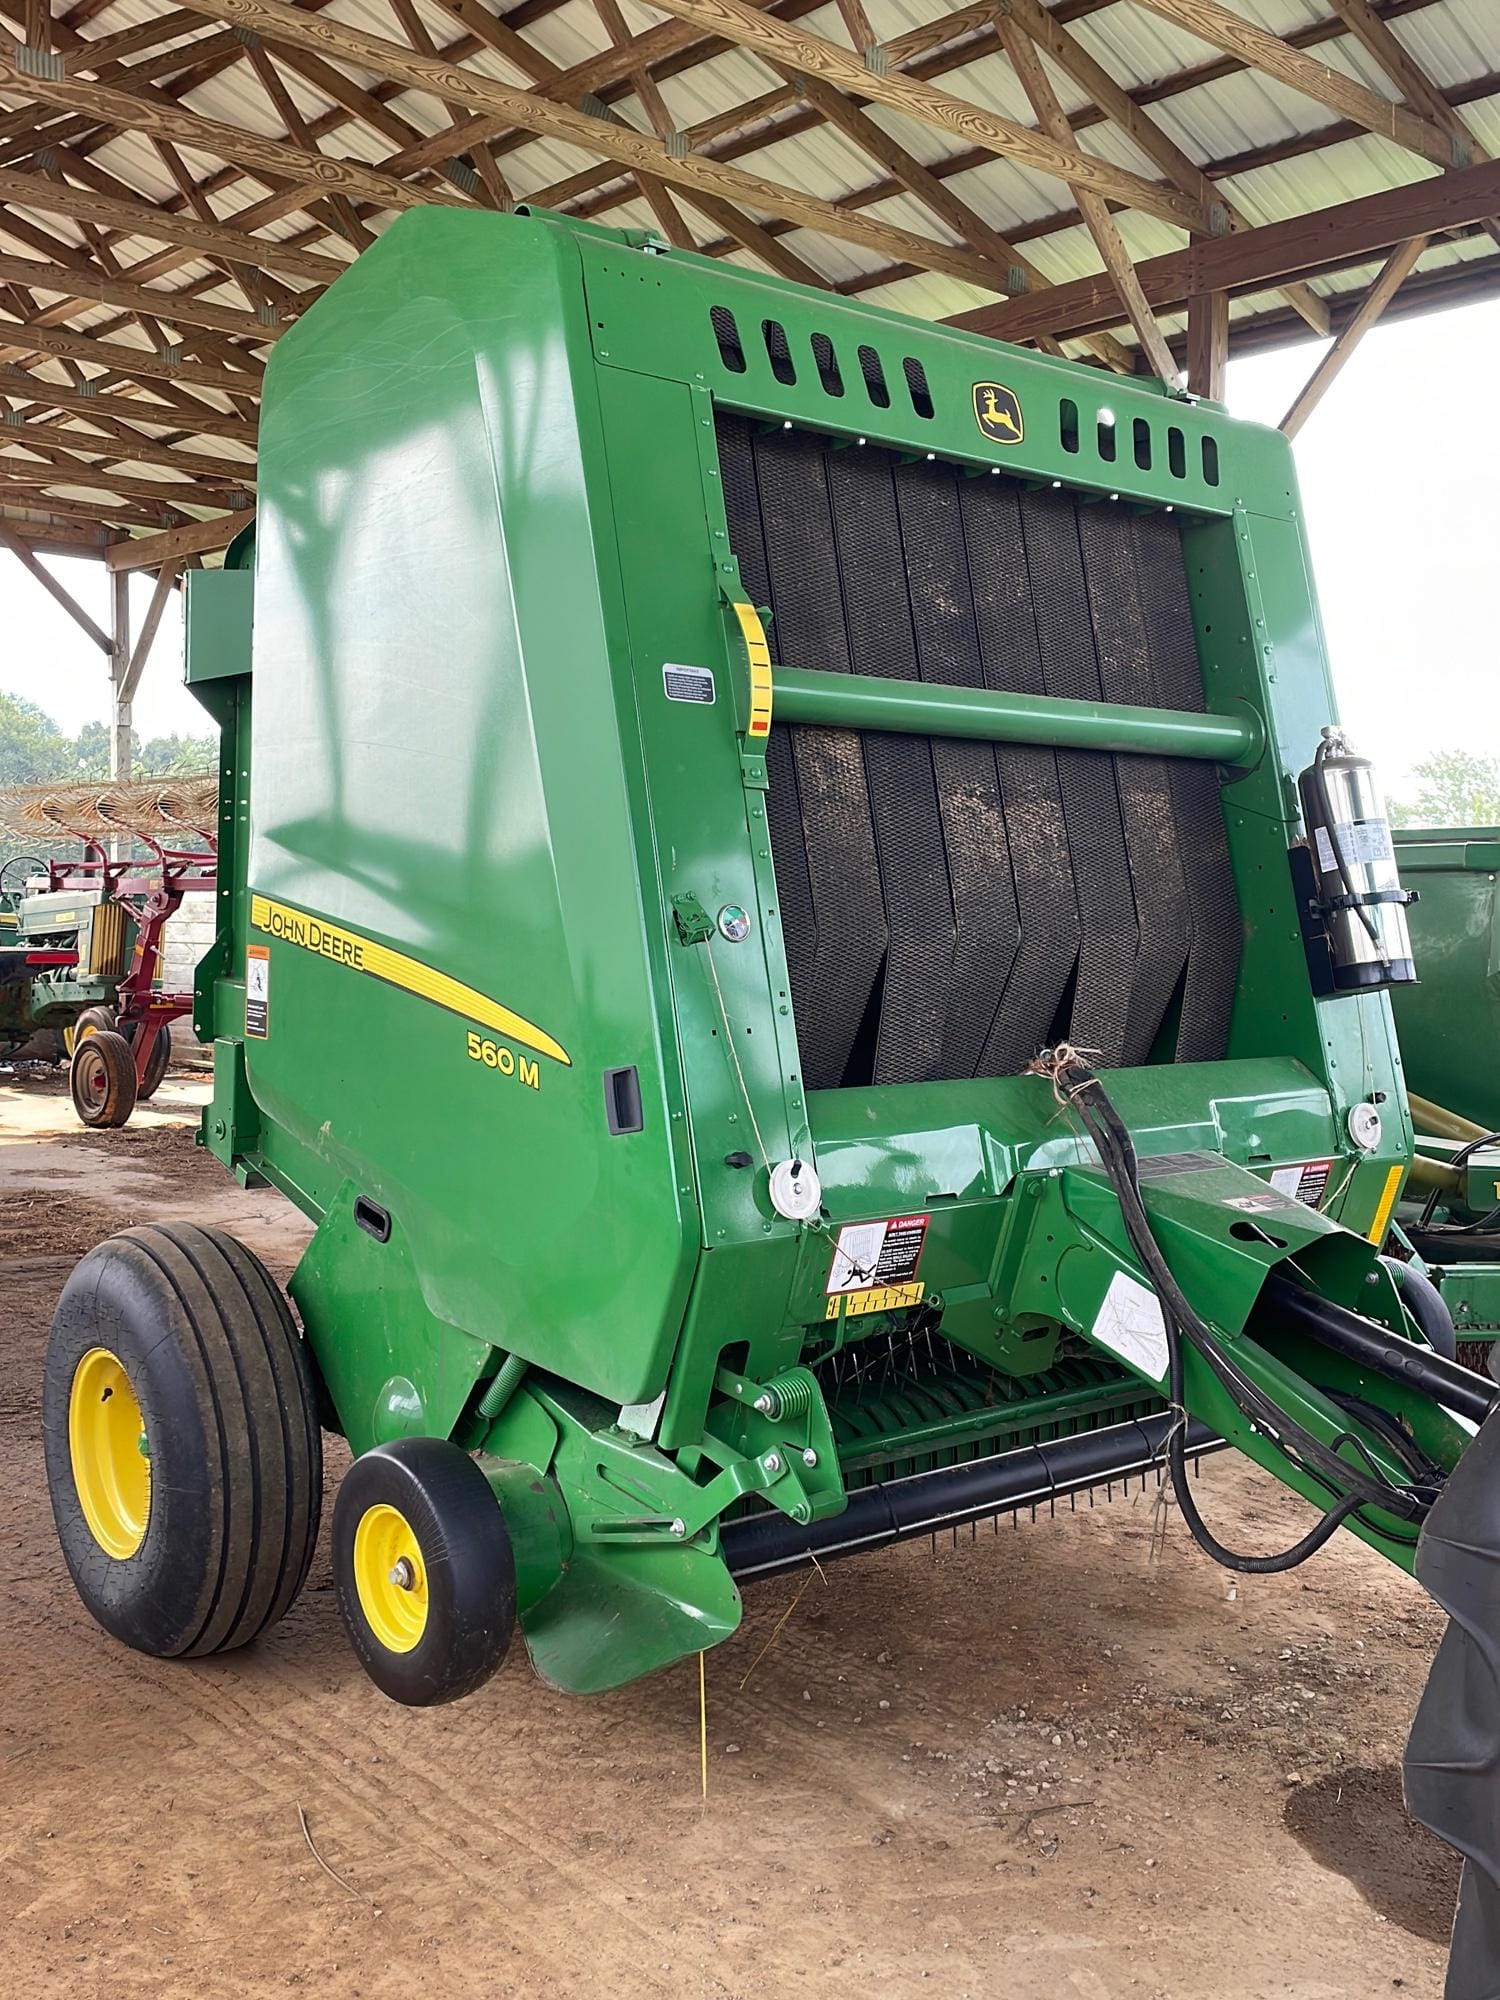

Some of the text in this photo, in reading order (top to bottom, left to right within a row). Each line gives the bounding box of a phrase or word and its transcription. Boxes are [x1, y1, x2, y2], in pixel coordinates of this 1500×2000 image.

[263, 906, 363, 966] JOHN DEERE
[467, 1030, 540, 1091] 560 M
[898, 1218, 925, 1229] DANGER
